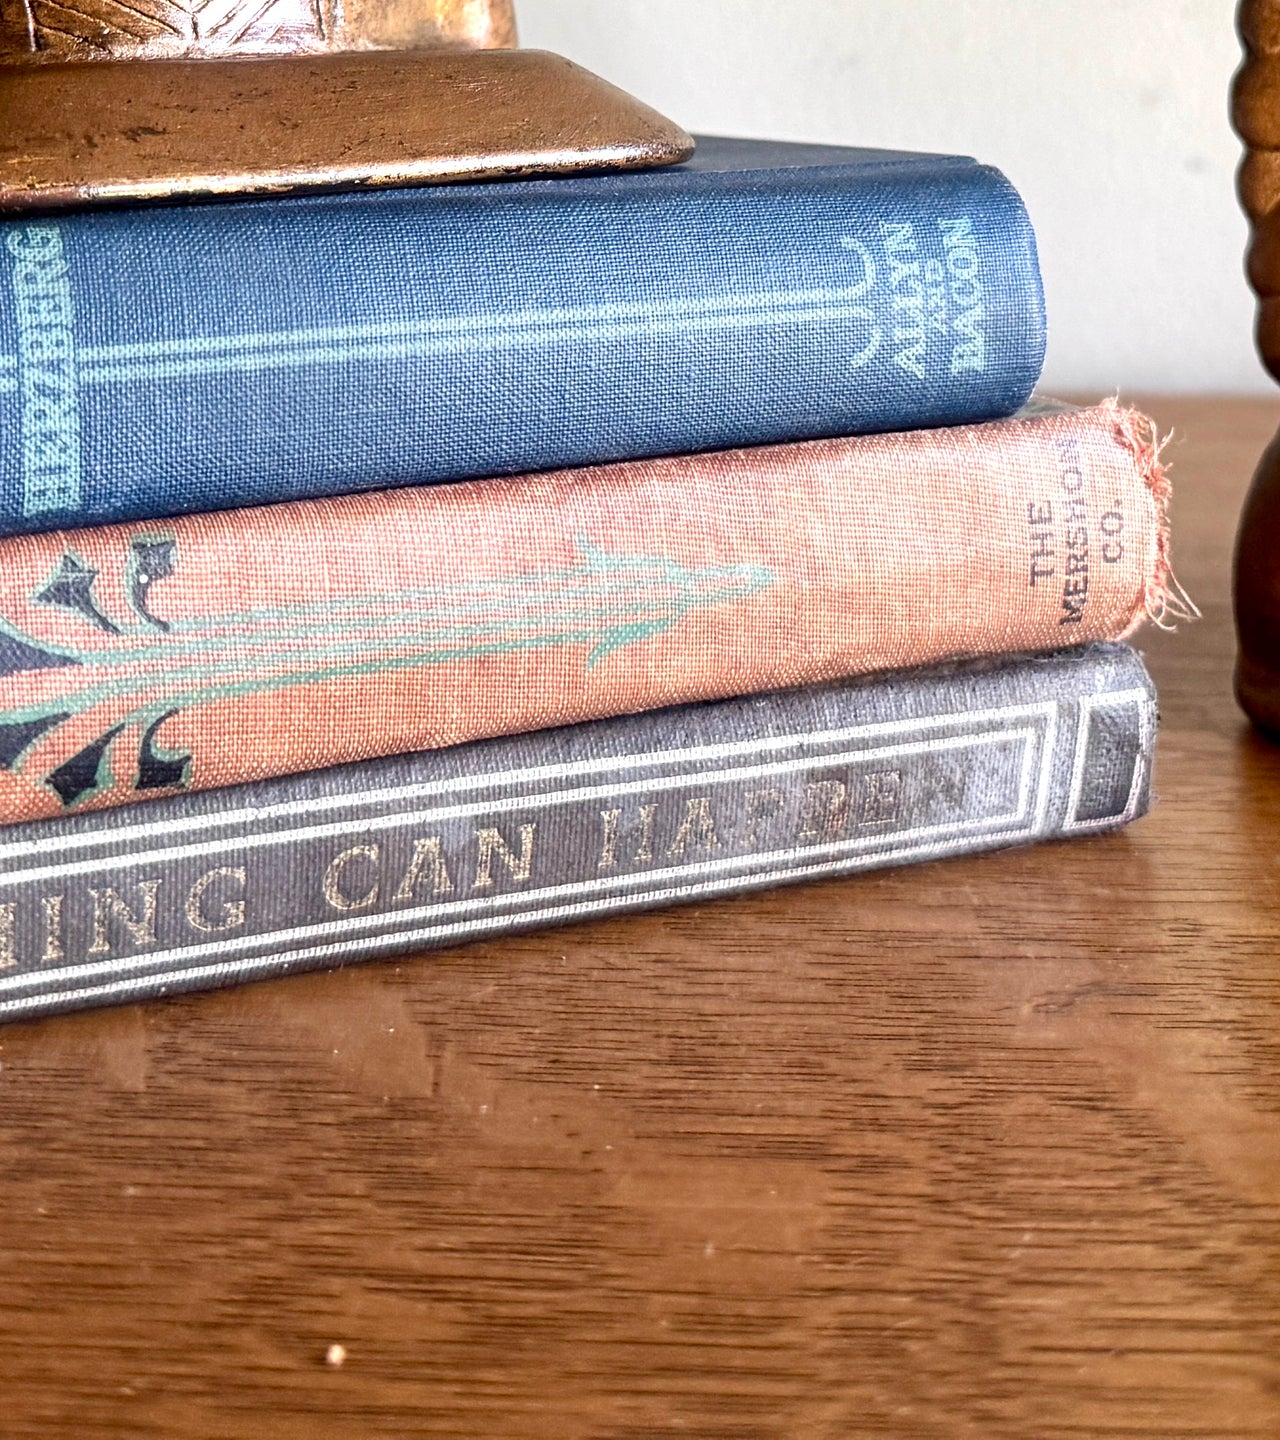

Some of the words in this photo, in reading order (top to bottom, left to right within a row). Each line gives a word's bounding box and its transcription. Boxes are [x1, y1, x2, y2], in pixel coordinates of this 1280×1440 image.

[6, 224, 81, 517] HERZBERG
[879, 220, 927, 379] ALLYN
[938, 215, 985, 375] BACON
[1027, 499, 1055, 588] THE
[1057, 438, 1089, 626] MERSHON
[1099, 498, 1125, 565] CO.
[322, 823, 536, 911] CAN
